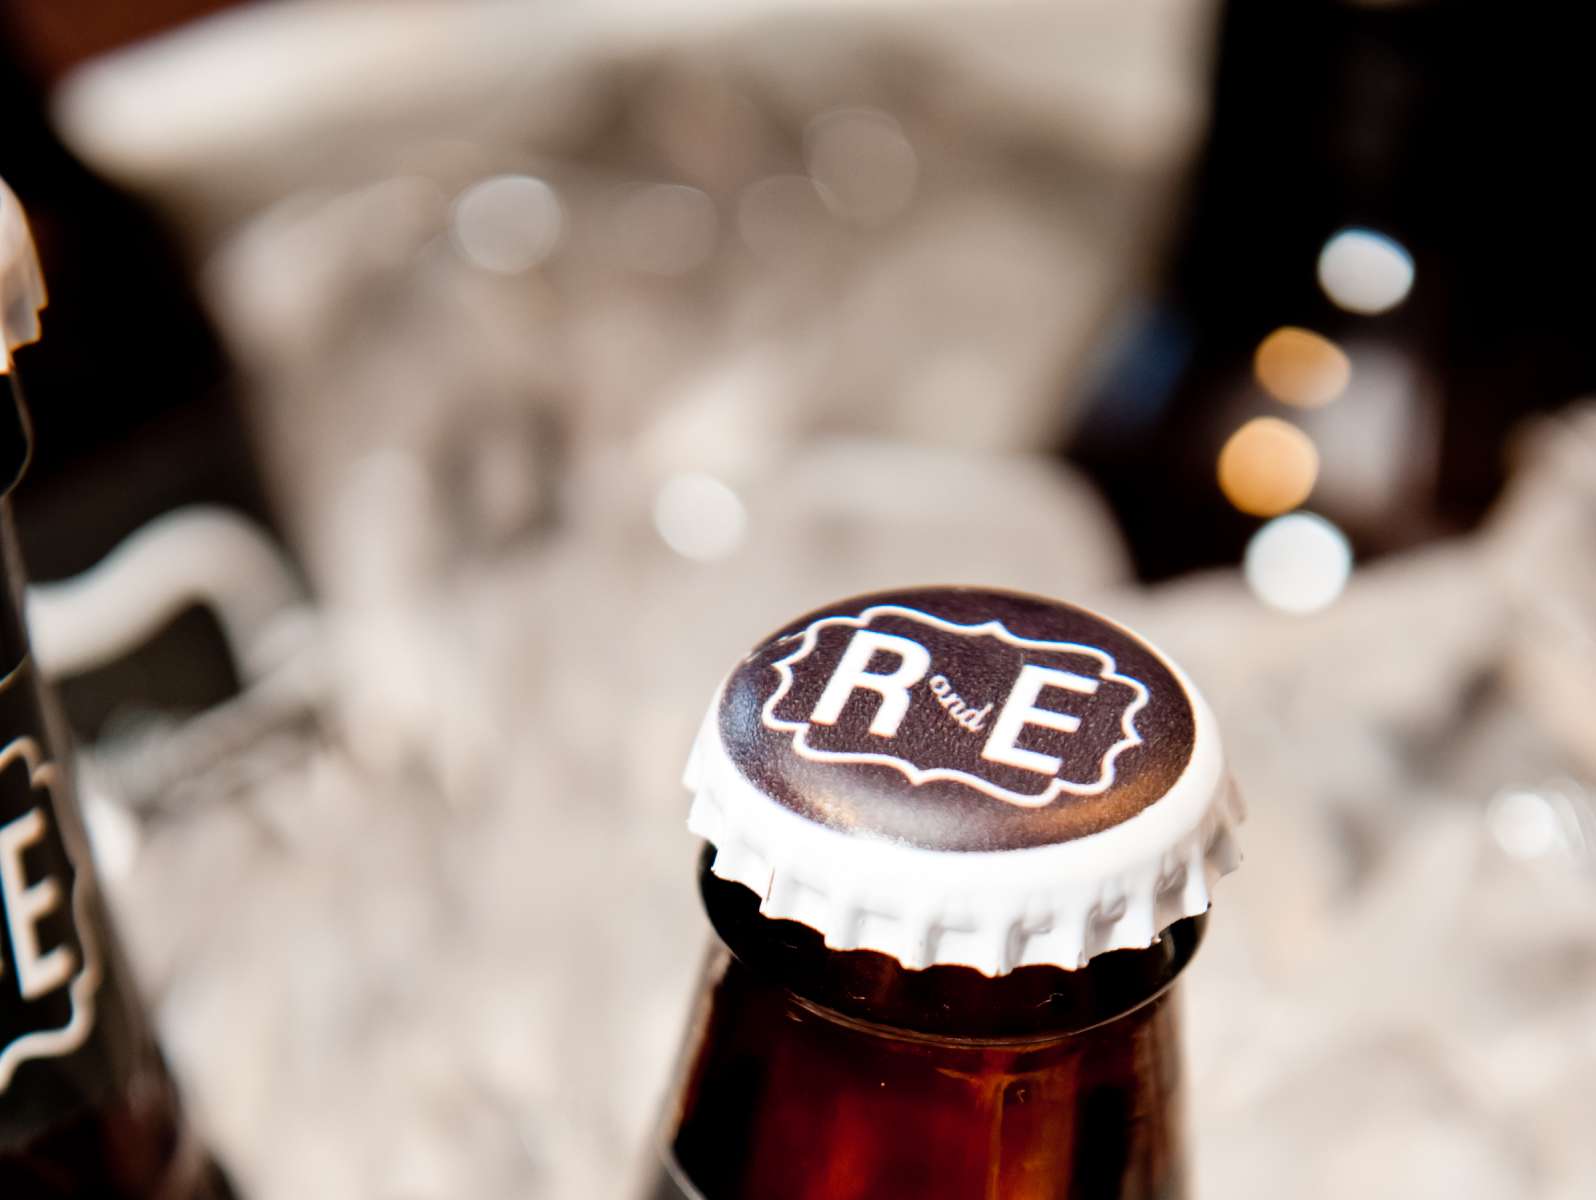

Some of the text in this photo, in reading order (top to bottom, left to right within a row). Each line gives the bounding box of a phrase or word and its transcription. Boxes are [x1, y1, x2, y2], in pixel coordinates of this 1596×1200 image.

[810, 629, 1098, 775] R and E
[0, 807, 76, 999] E
